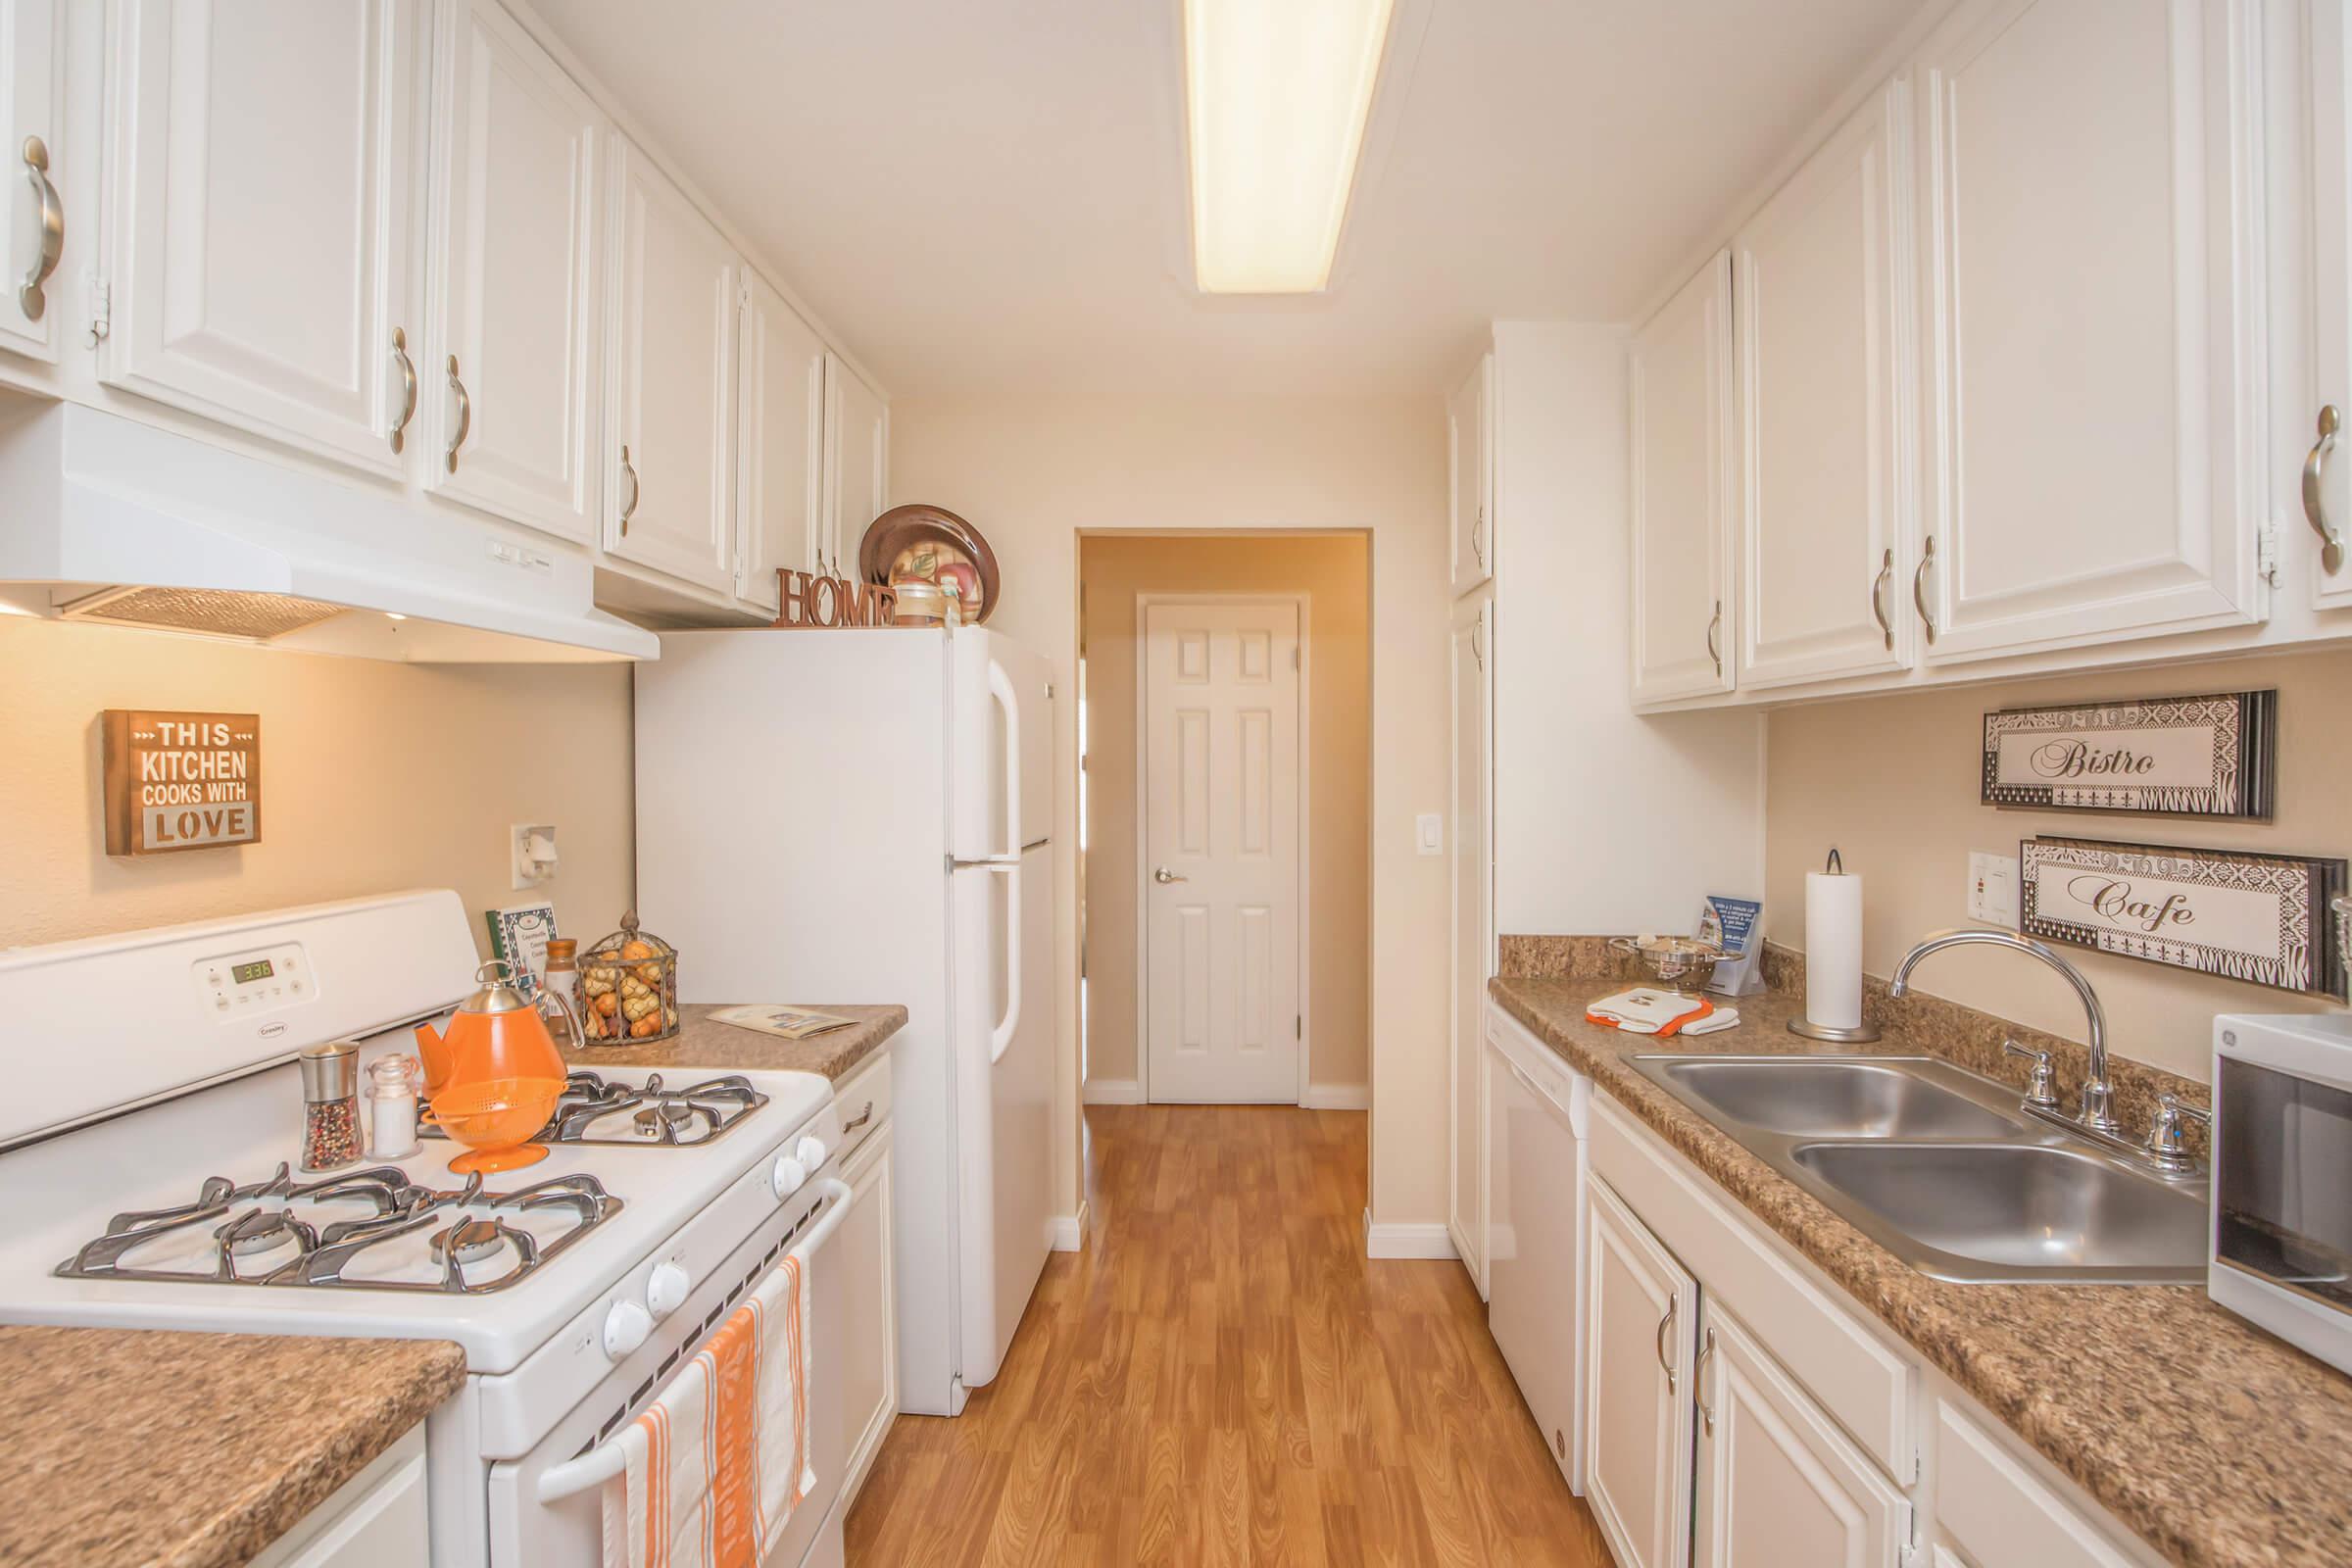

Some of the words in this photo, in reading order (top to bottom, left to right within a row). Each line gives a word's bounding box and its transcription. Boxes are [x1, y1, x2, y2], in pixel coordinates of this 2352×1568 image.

[157, 722, 230, 747] THIS
[141, 751, 247, 782] KITCHEN
[2030, 738, 2156, 778] Bistro
[142, 784, 202, 806] COOKS
[207, 782, 247, 803] WITH
[156, 808, 246, 843] LOVE
[2067, 875, 2196, 932] Cafe
